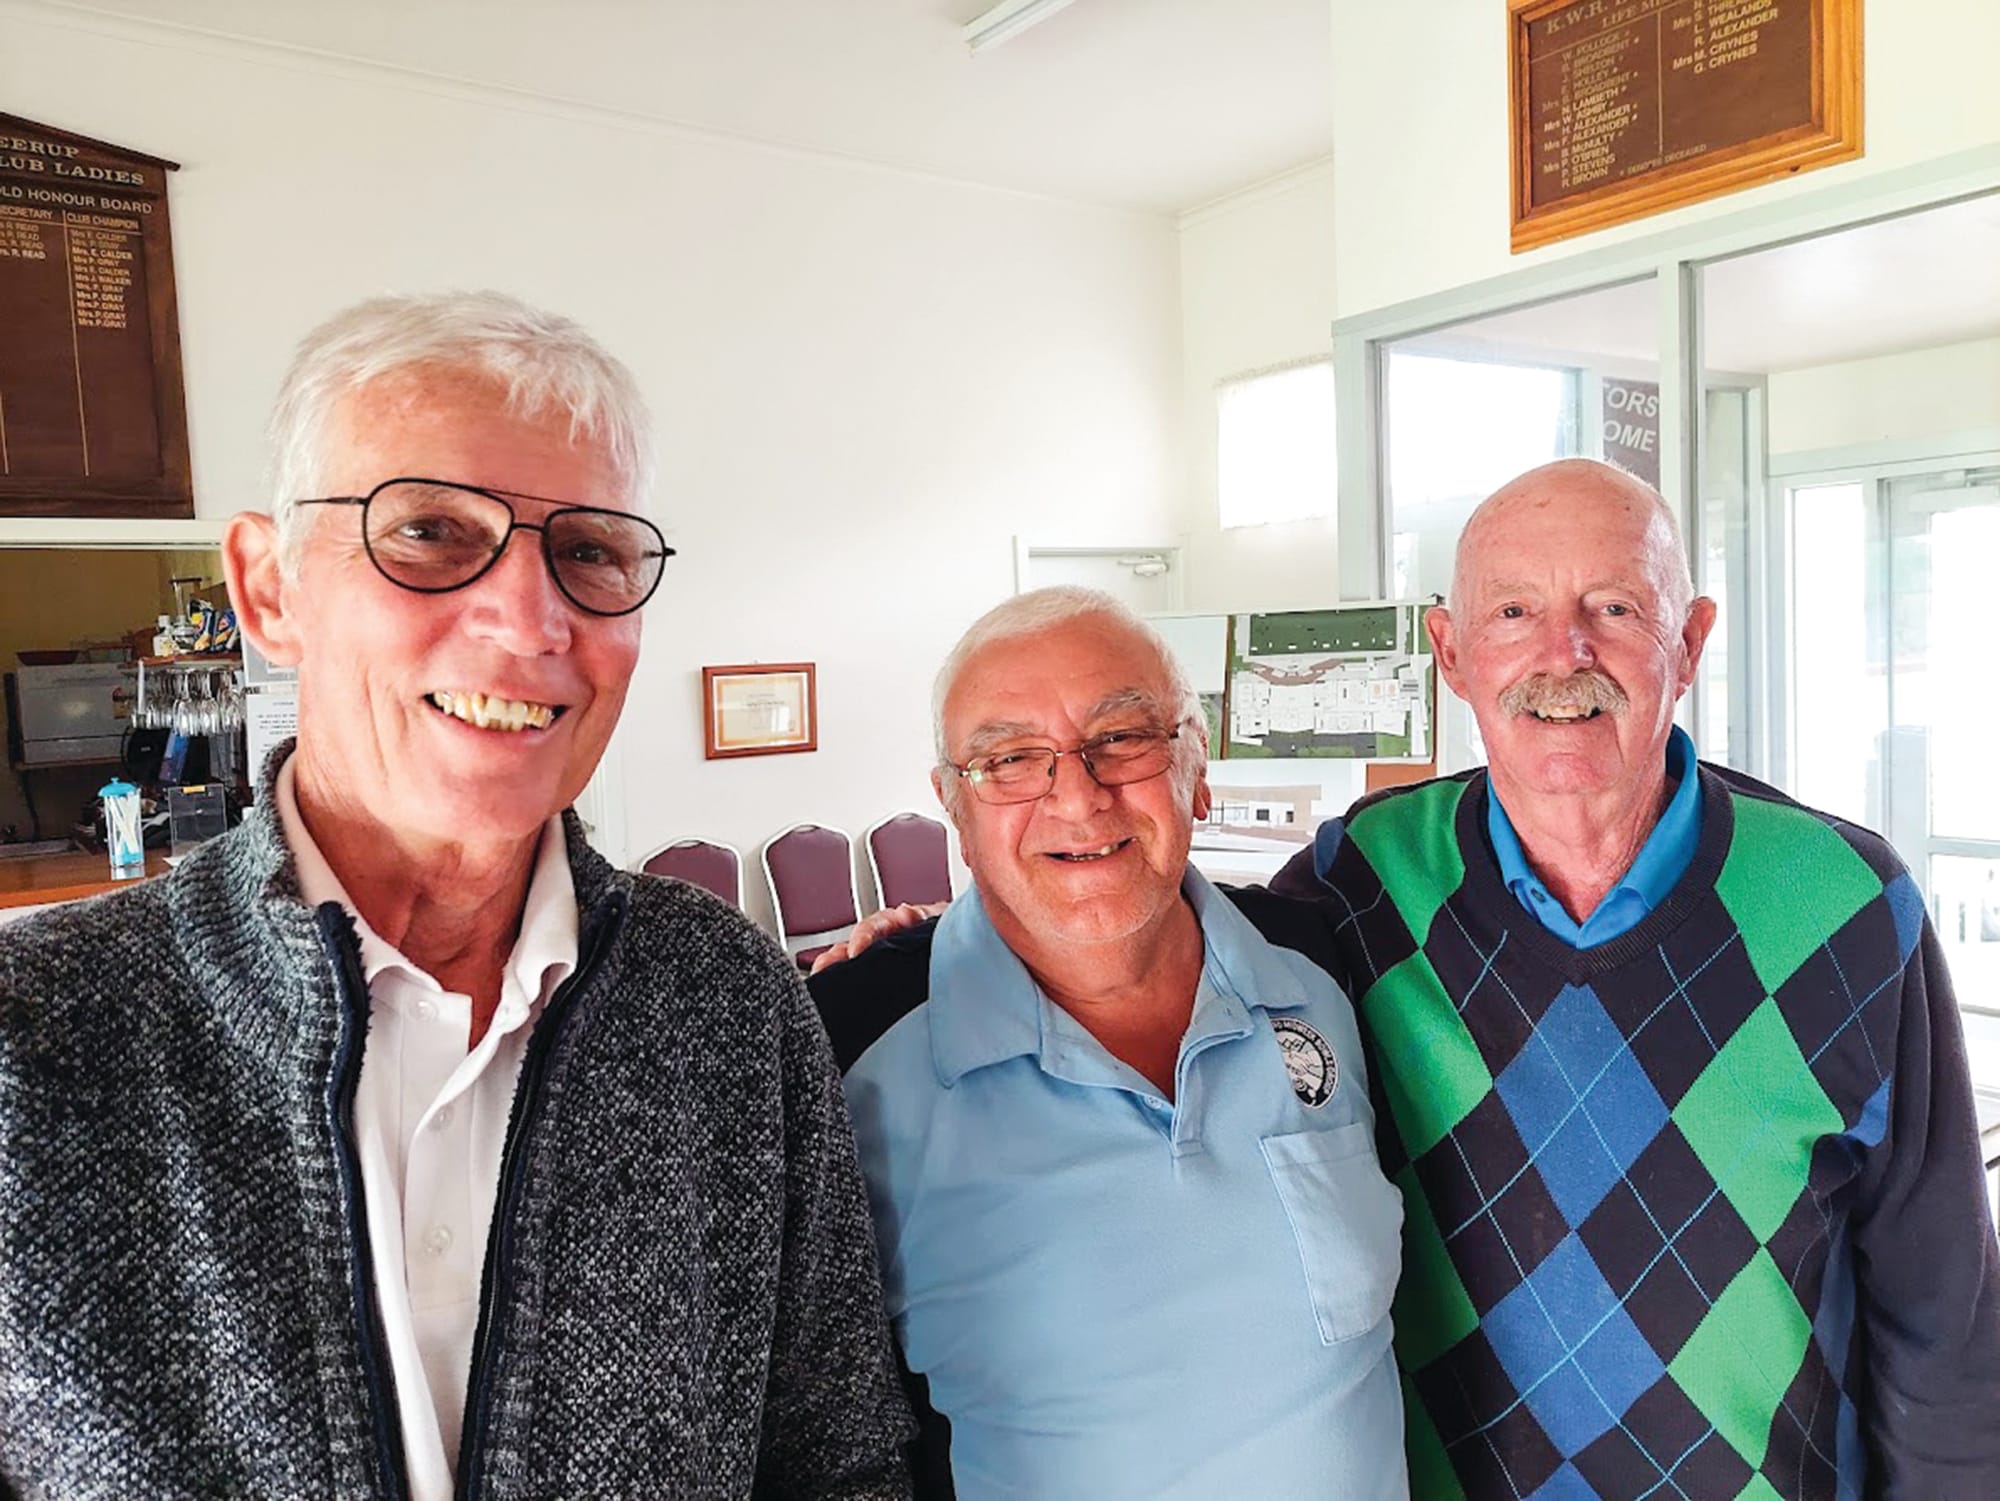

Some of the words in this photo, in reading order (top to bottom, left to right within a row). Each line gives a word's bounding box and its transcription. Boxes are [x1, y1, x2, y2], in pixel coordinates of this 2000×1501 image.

[1710, 7, 1778, 41] ALEXANDER
[1673, 55, 1692, 70] Mrs
[1572, 116, 1629, 143] ALEXANDER
[1573, 103, 1631, 132] ALEXANDER
[55, 162, 144, 186] LADIES
[0, 185, 22, 198] LD
[28, 188, 95, 207] HONOUR
[100, 197, 152, 214] BOARD
[66, 212, 91, 225] CLUB
[92, 215, 139, 230] CHAMPION
[100, 249, 133, 261] CALDER
[1603, 383, 1659, 418] ORS
